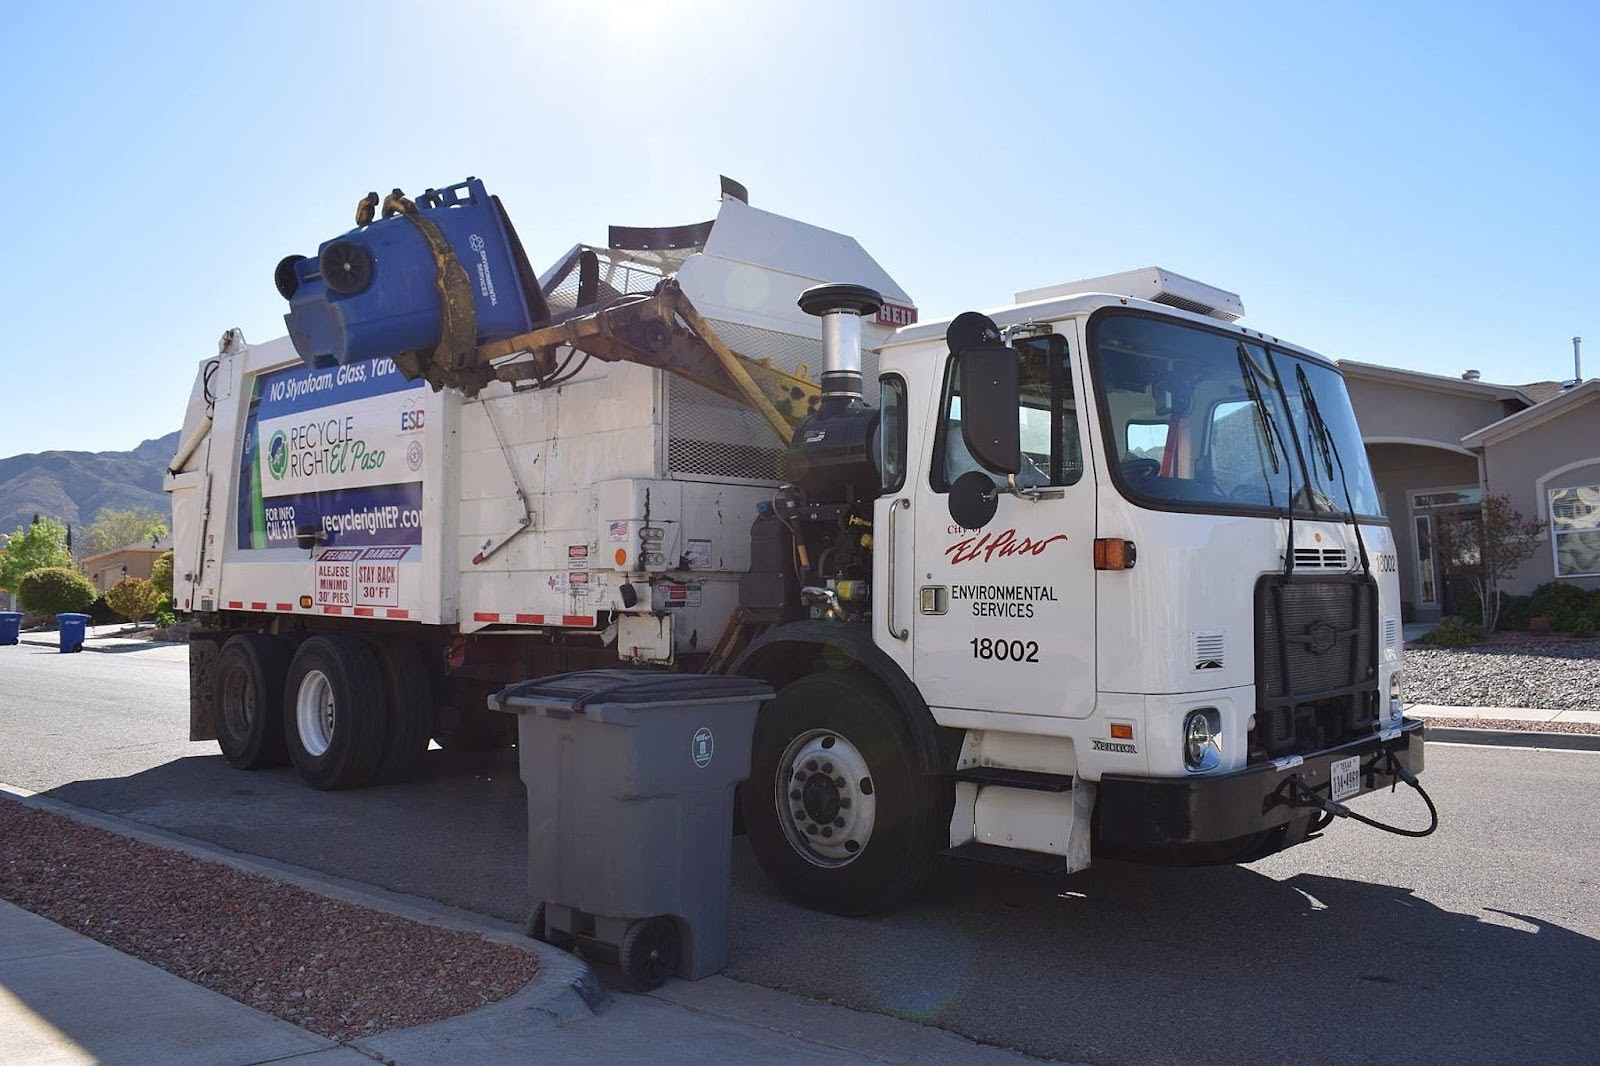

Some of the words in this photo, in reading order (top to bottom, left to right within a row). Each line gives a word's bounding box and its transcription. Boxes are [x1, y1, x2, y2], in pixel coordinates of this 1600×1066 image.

[270, 383, 285, 402] NO
[286, 373, 334, 402] Styrofoam,
[336, 364, 367, 386] Glass,
[401, 409, 425, 431] ESD
[291, 416, 353, 450] RECYCLE
[291, 449, 331, 478] RIGHT
[329, 441, 347, 475] El
[351, 439, 386, 472] Paso
[265, 507, 279, 520] FOR
[279, 505, 295, 520] INFO
[266, 521, 282, 540] CALL
[281, 520, 297, 540] 311
[367, 547, 405, 560] DANGER
[945, 532, 991, 565] El
[985, 528, 1068, 563] Paso
[319, 566, 350, 577] ALEJESE
[359, 566, 376, 584] STAY
[377, 566, 396, 584] BACK
[320, 579, 348, 591] MINIMO
[951, 585, 1058, 601] ENVIRONMENTAL
[332, 592, 350, 604] PIES
[972, 602, 1034, 618] SERVICES
[970, 637, 1039, 663] 18002
